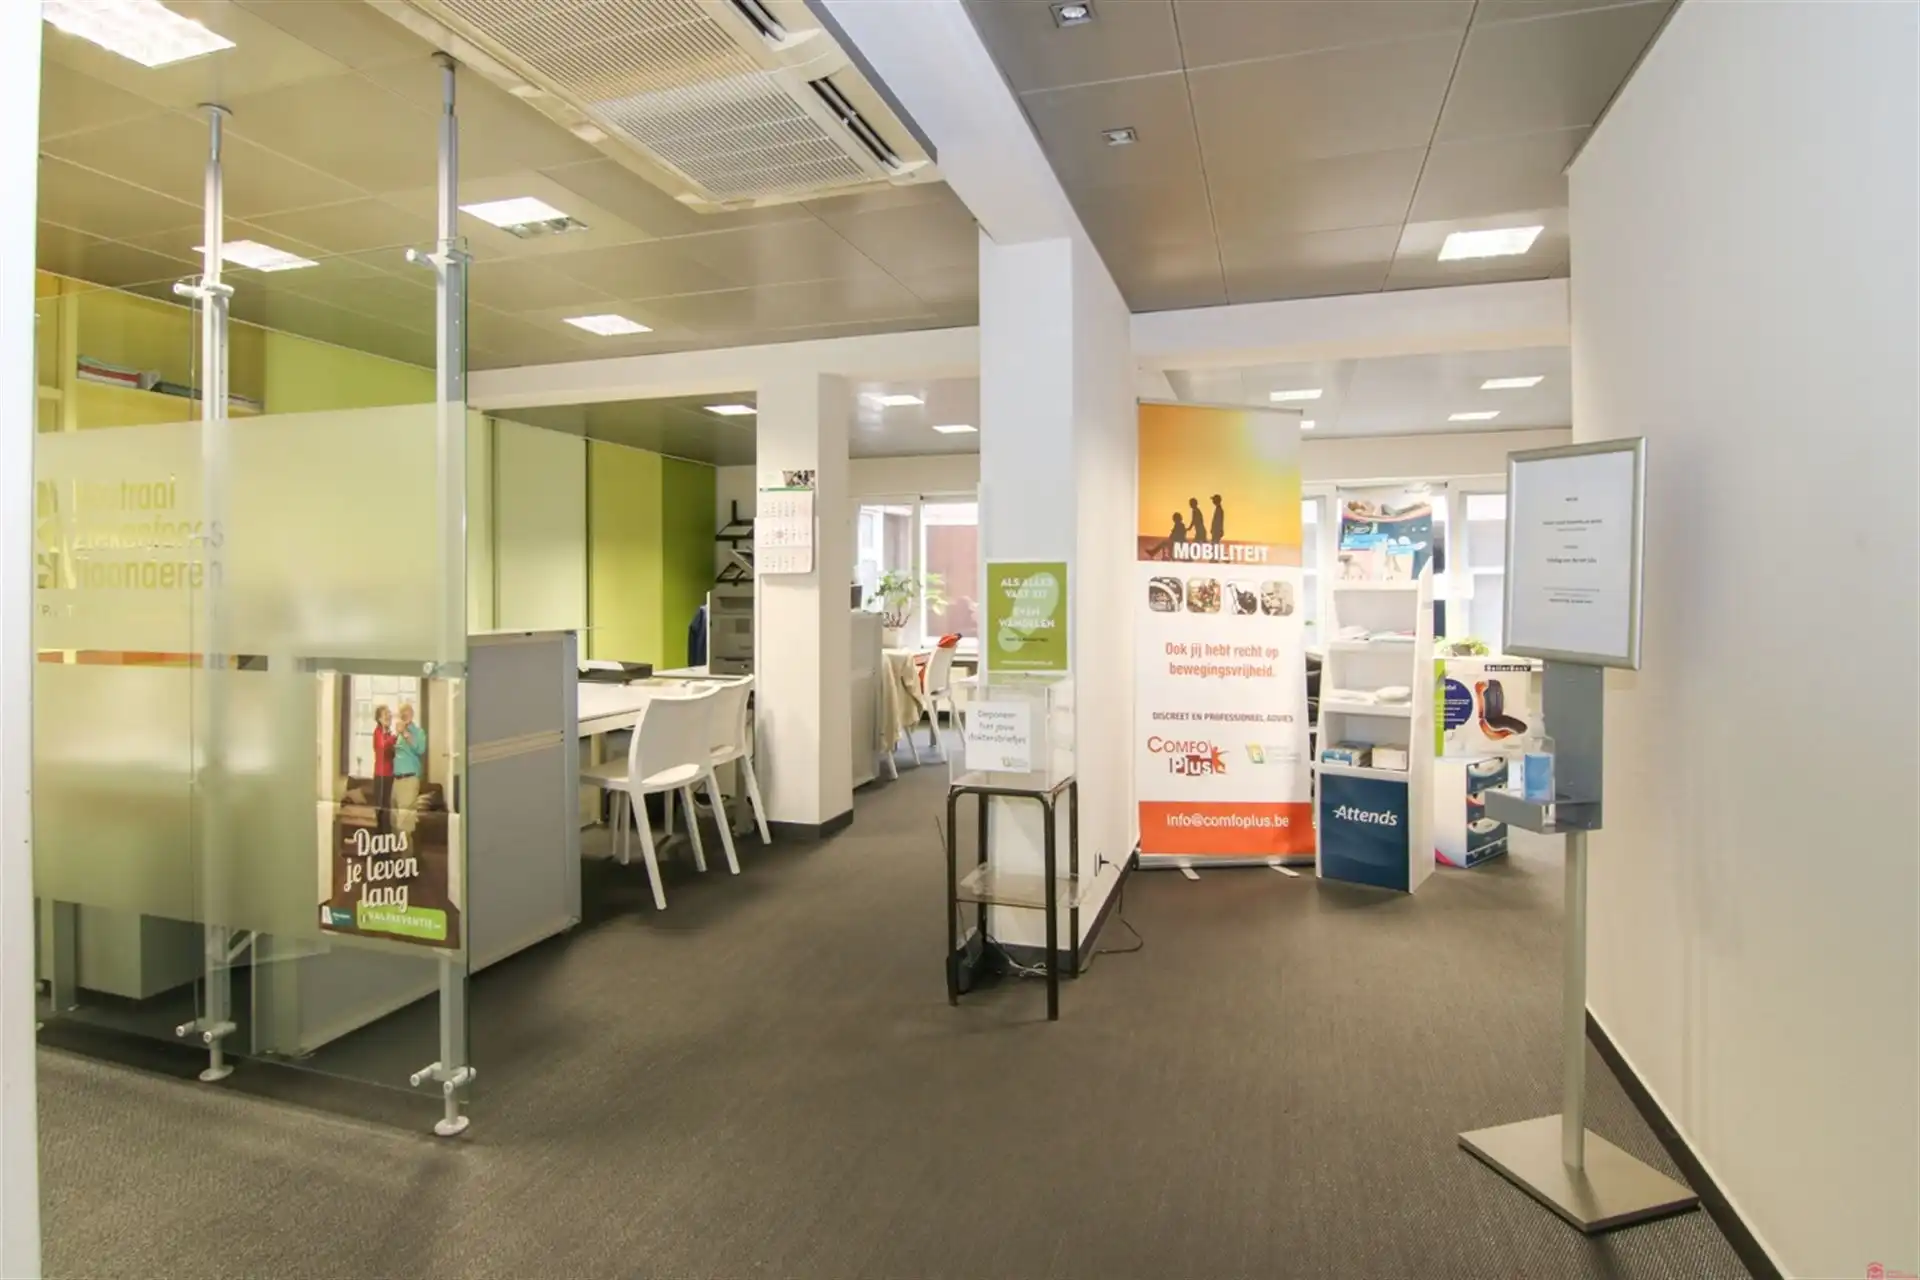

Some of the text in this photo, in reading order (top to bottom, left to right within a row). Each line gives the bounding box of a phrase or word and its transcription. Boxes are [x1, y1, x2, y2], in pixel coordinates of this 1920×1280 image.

[1173, 541, 1268, 562] MOBILITEIT
[1165, 642, 1279, 660] Ook jij hebt recht op
[1169, 662, 1278, 679] bewegingsvrijheid.
[1152, 711, 1294, 723] DISCREET EN PROFESSIONEEL ADVIES
[1166, 813, 1289, 829] info@comfoplus.be
[1332, 805, 1398, 827] Attends
[344, 828, 408, 857] Dans
[344, 856, 420, 892] je leven
[361, 882, 408, 914] lang
